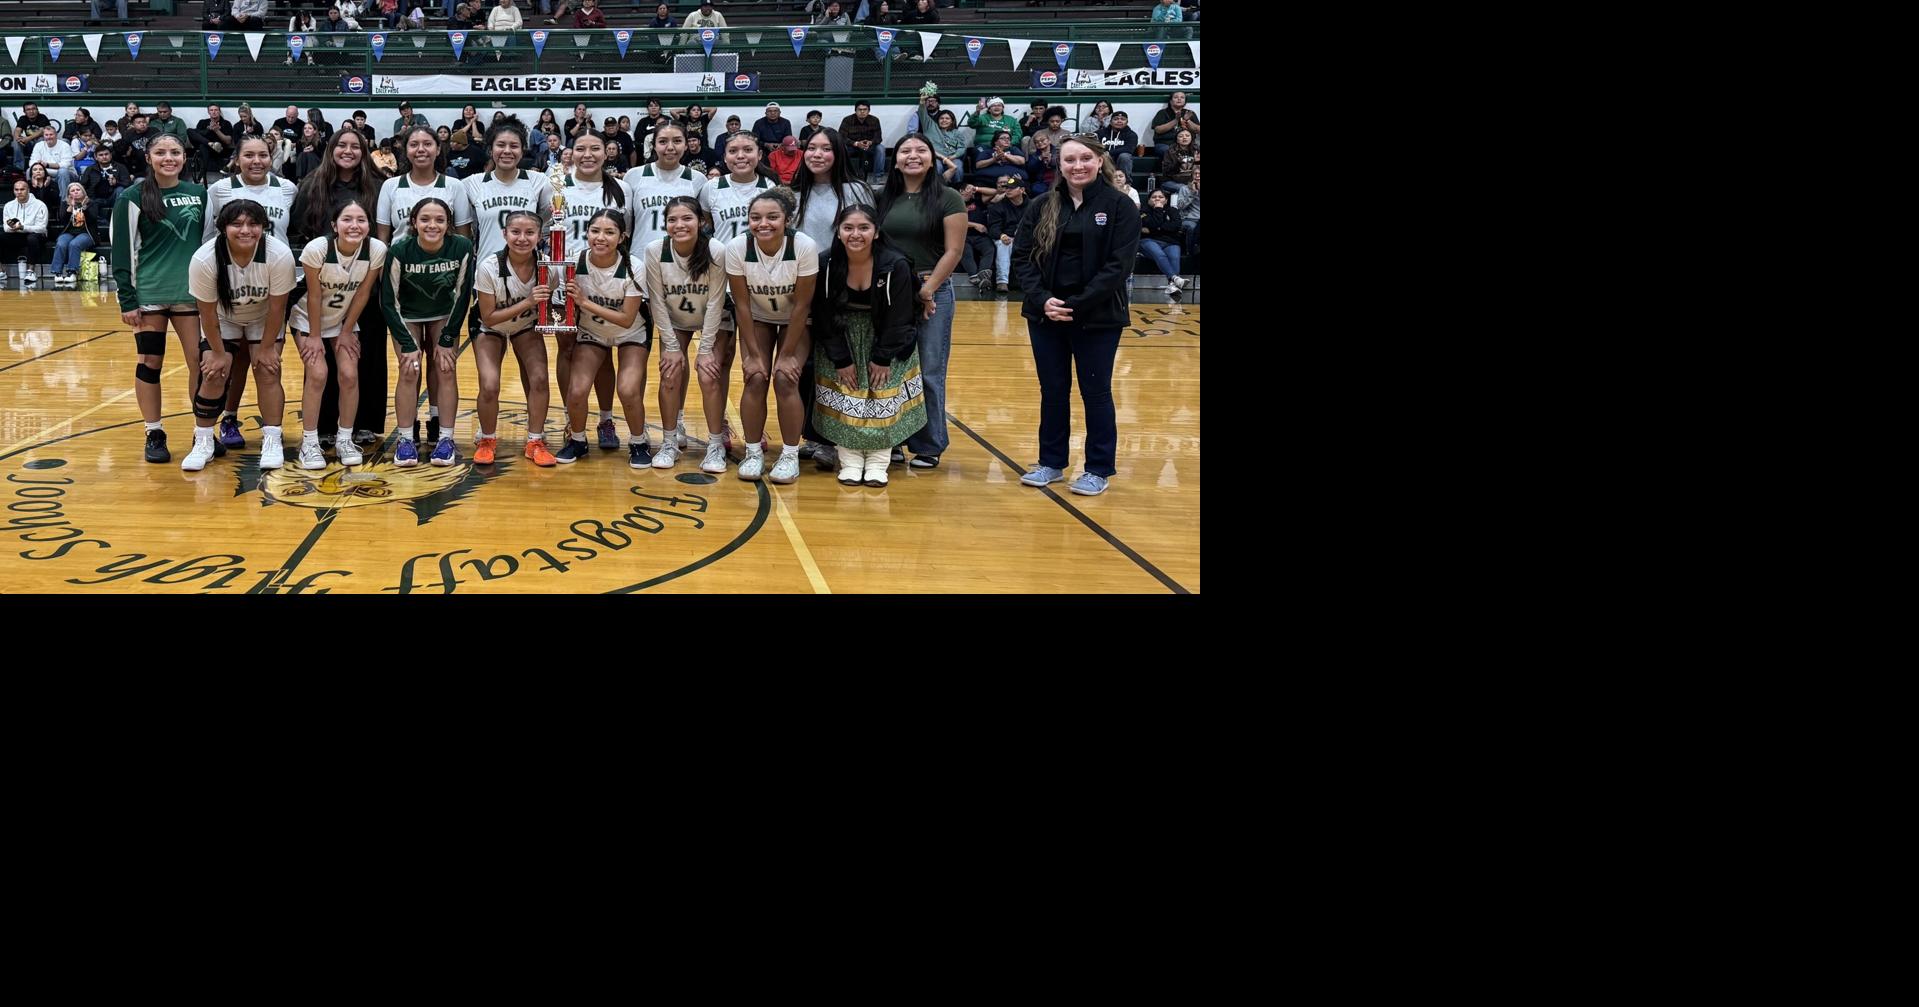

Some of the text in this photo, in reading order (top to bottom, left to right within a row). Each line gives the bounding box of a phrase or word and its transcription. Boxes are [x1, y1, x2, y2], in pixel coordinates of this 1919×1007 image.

[470, 77, 622, 92] EAGLES' AERIE
[1104, 70, 1199, 86] EAGLES'
[171, 196, 202, 207] EAGLES
[482, 196, 529, 210] FLAGSTAFF
[405, 260, 460, 273] LADY EAGLES
[328, 294, 345, 308] 2
[678, 296, 696, 313] 4
[768, 298, 778, 311] 1
[0, 473, 112, 560] School
[381, 485, 708, 594] Flagstaff
